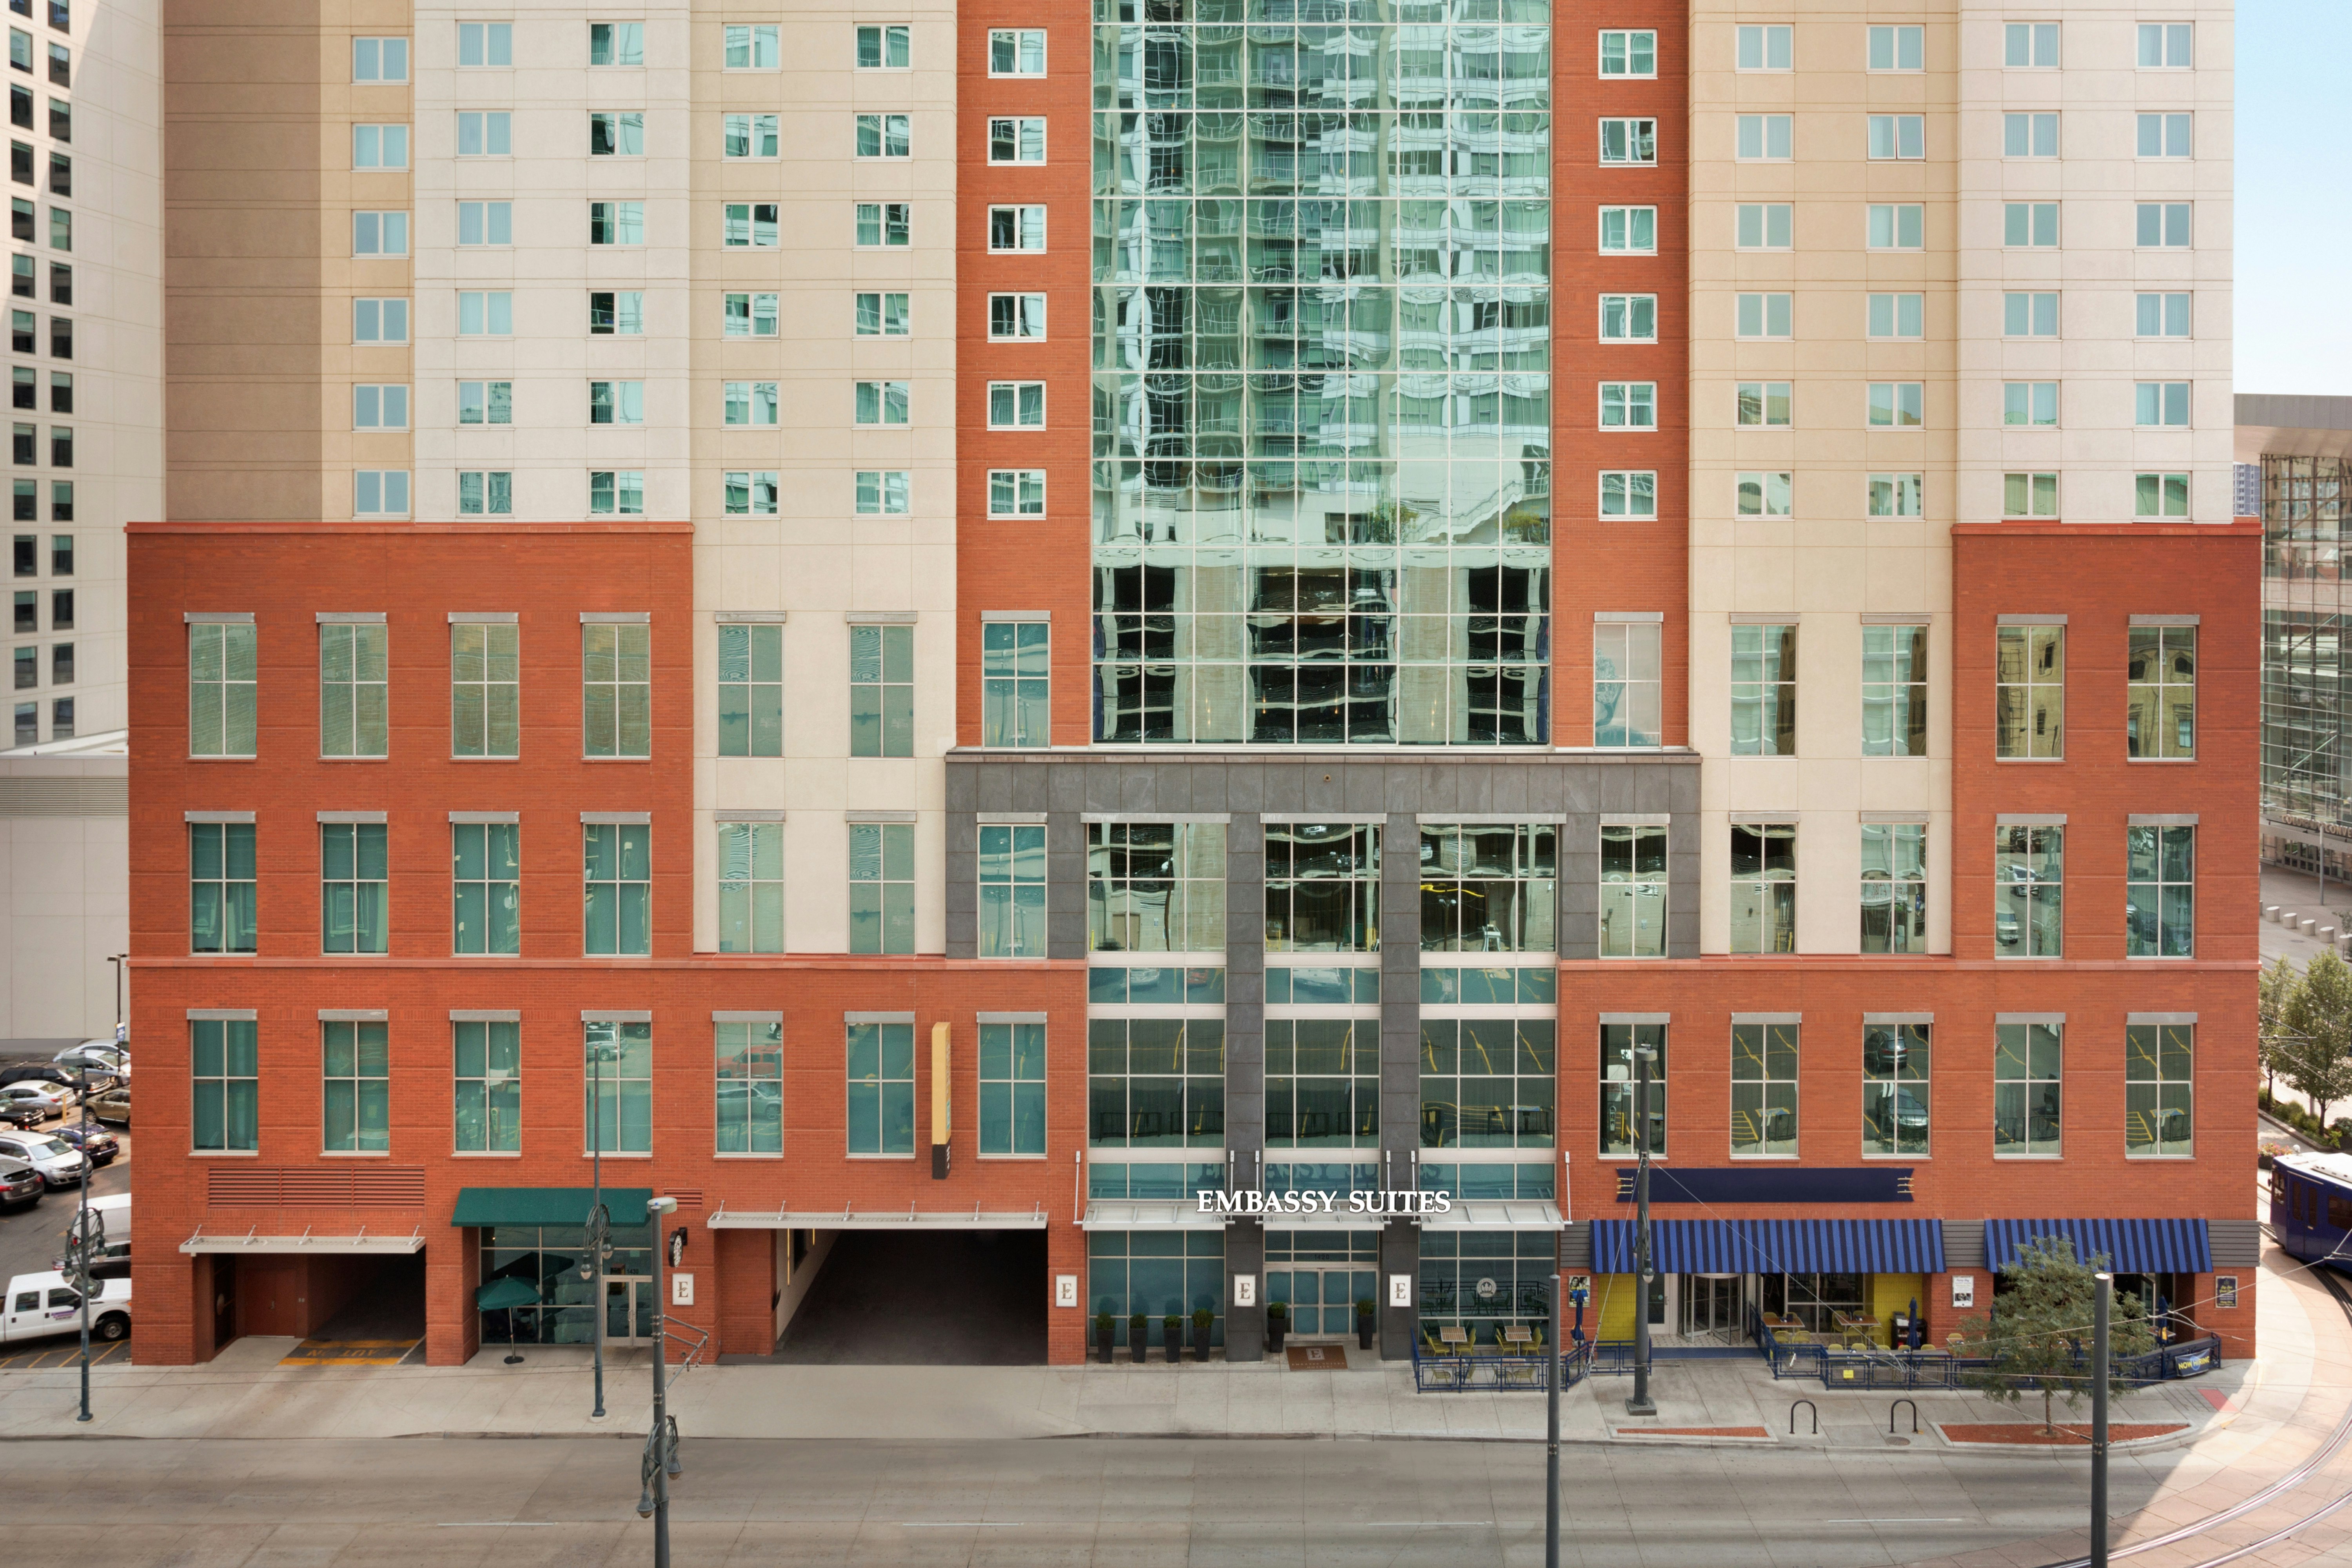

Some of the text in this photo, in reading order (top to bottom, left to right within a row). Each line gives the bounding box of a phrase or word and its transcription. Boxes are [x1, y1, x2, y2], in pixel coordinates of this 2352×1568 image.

[1196, 1190, 1451, 1213] EMBASSY SUITES
[677, 1281, 688, 1298] E
[1061, 1283, 1072, 1299] E
[1239, 1283, 1250, 1299] E
[1395, 1283, 1406, 1299] E
[2178, 1361, 2192, 1370] NOW
